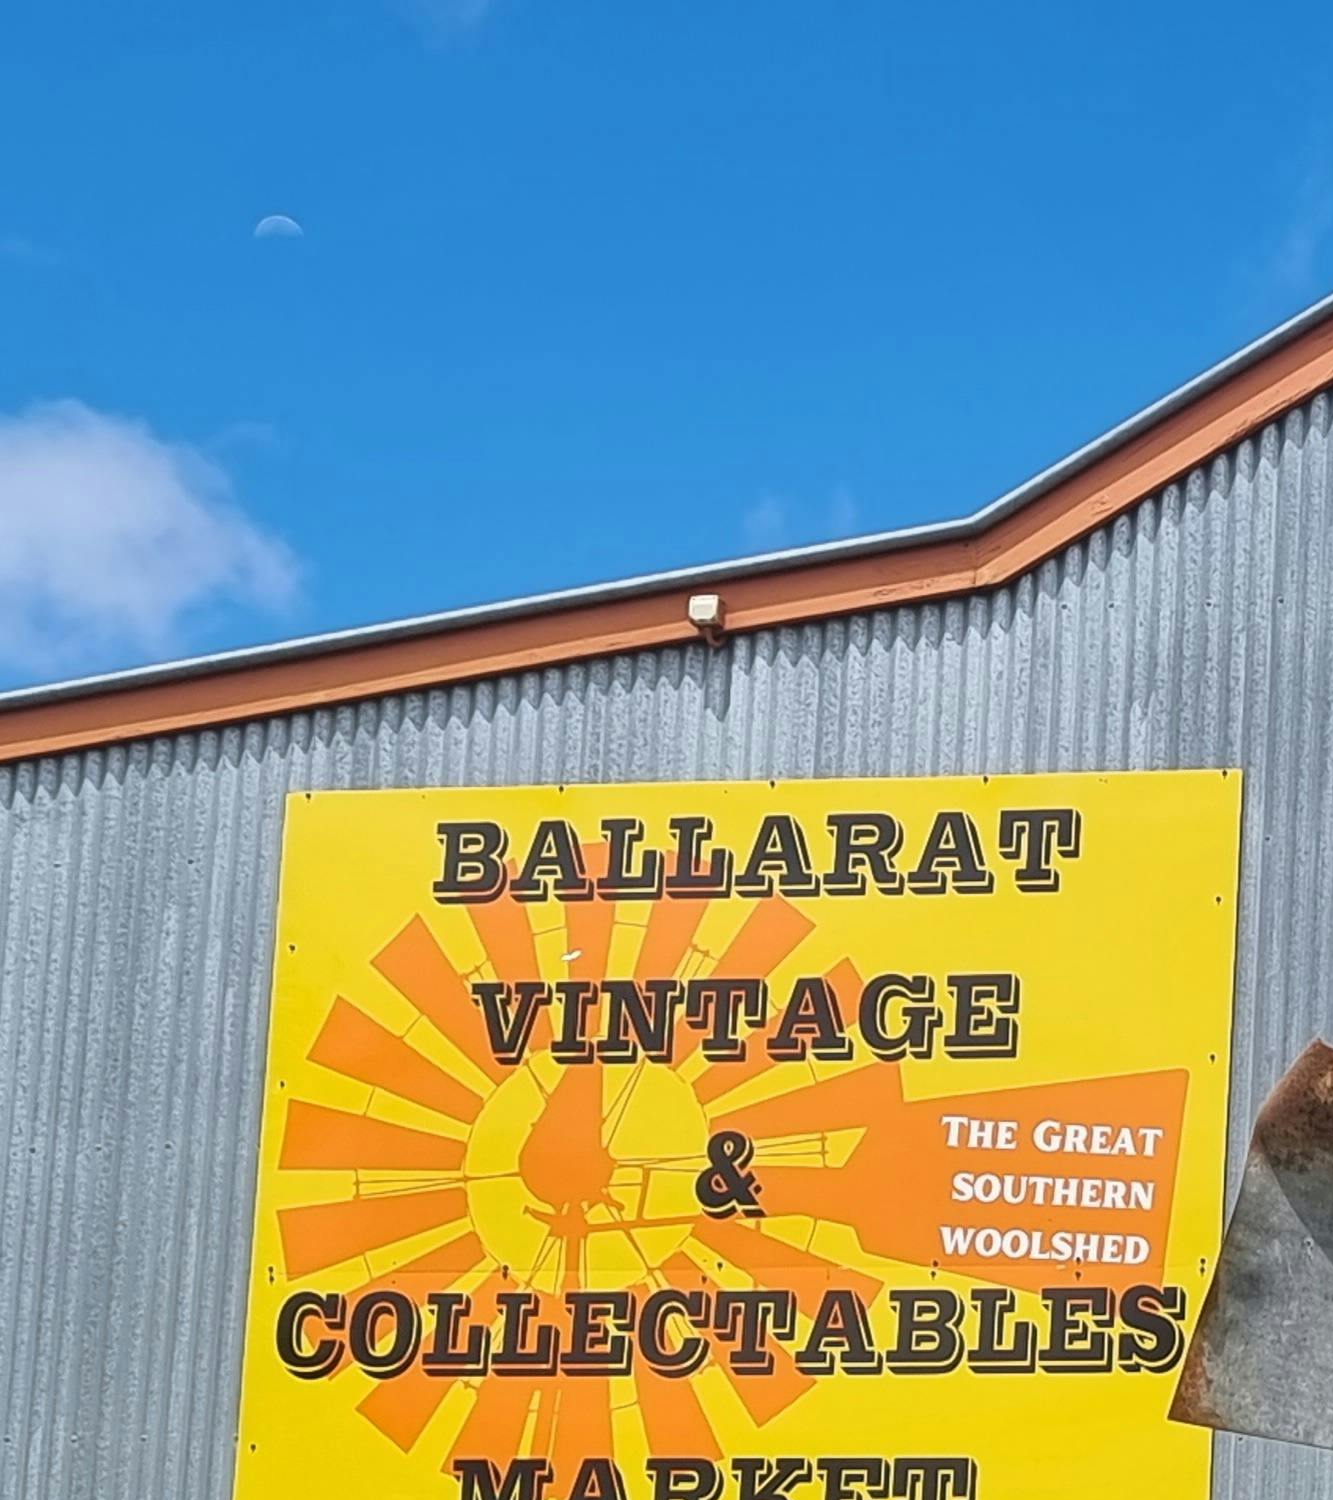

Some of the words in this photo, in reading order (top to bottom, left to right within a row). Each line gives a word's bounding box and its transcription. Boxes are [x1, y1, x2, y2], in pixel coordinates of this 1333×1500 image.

[434, 810, 1081, 904] BALLARAT
[473, 974, 1019, 1064] VINTAGE
[696, 1132, 764, 1219] &
[943, 1117, 1017, 1149] THE
[1034, 1121, 1162, 1156] GREAT
[953, 1173, 1153, 1209] SOUTHERN
[940, 1226, 1150, 1265] WOOLSHED
[277, 1285, 1187, 1376] COLLECTABLES
